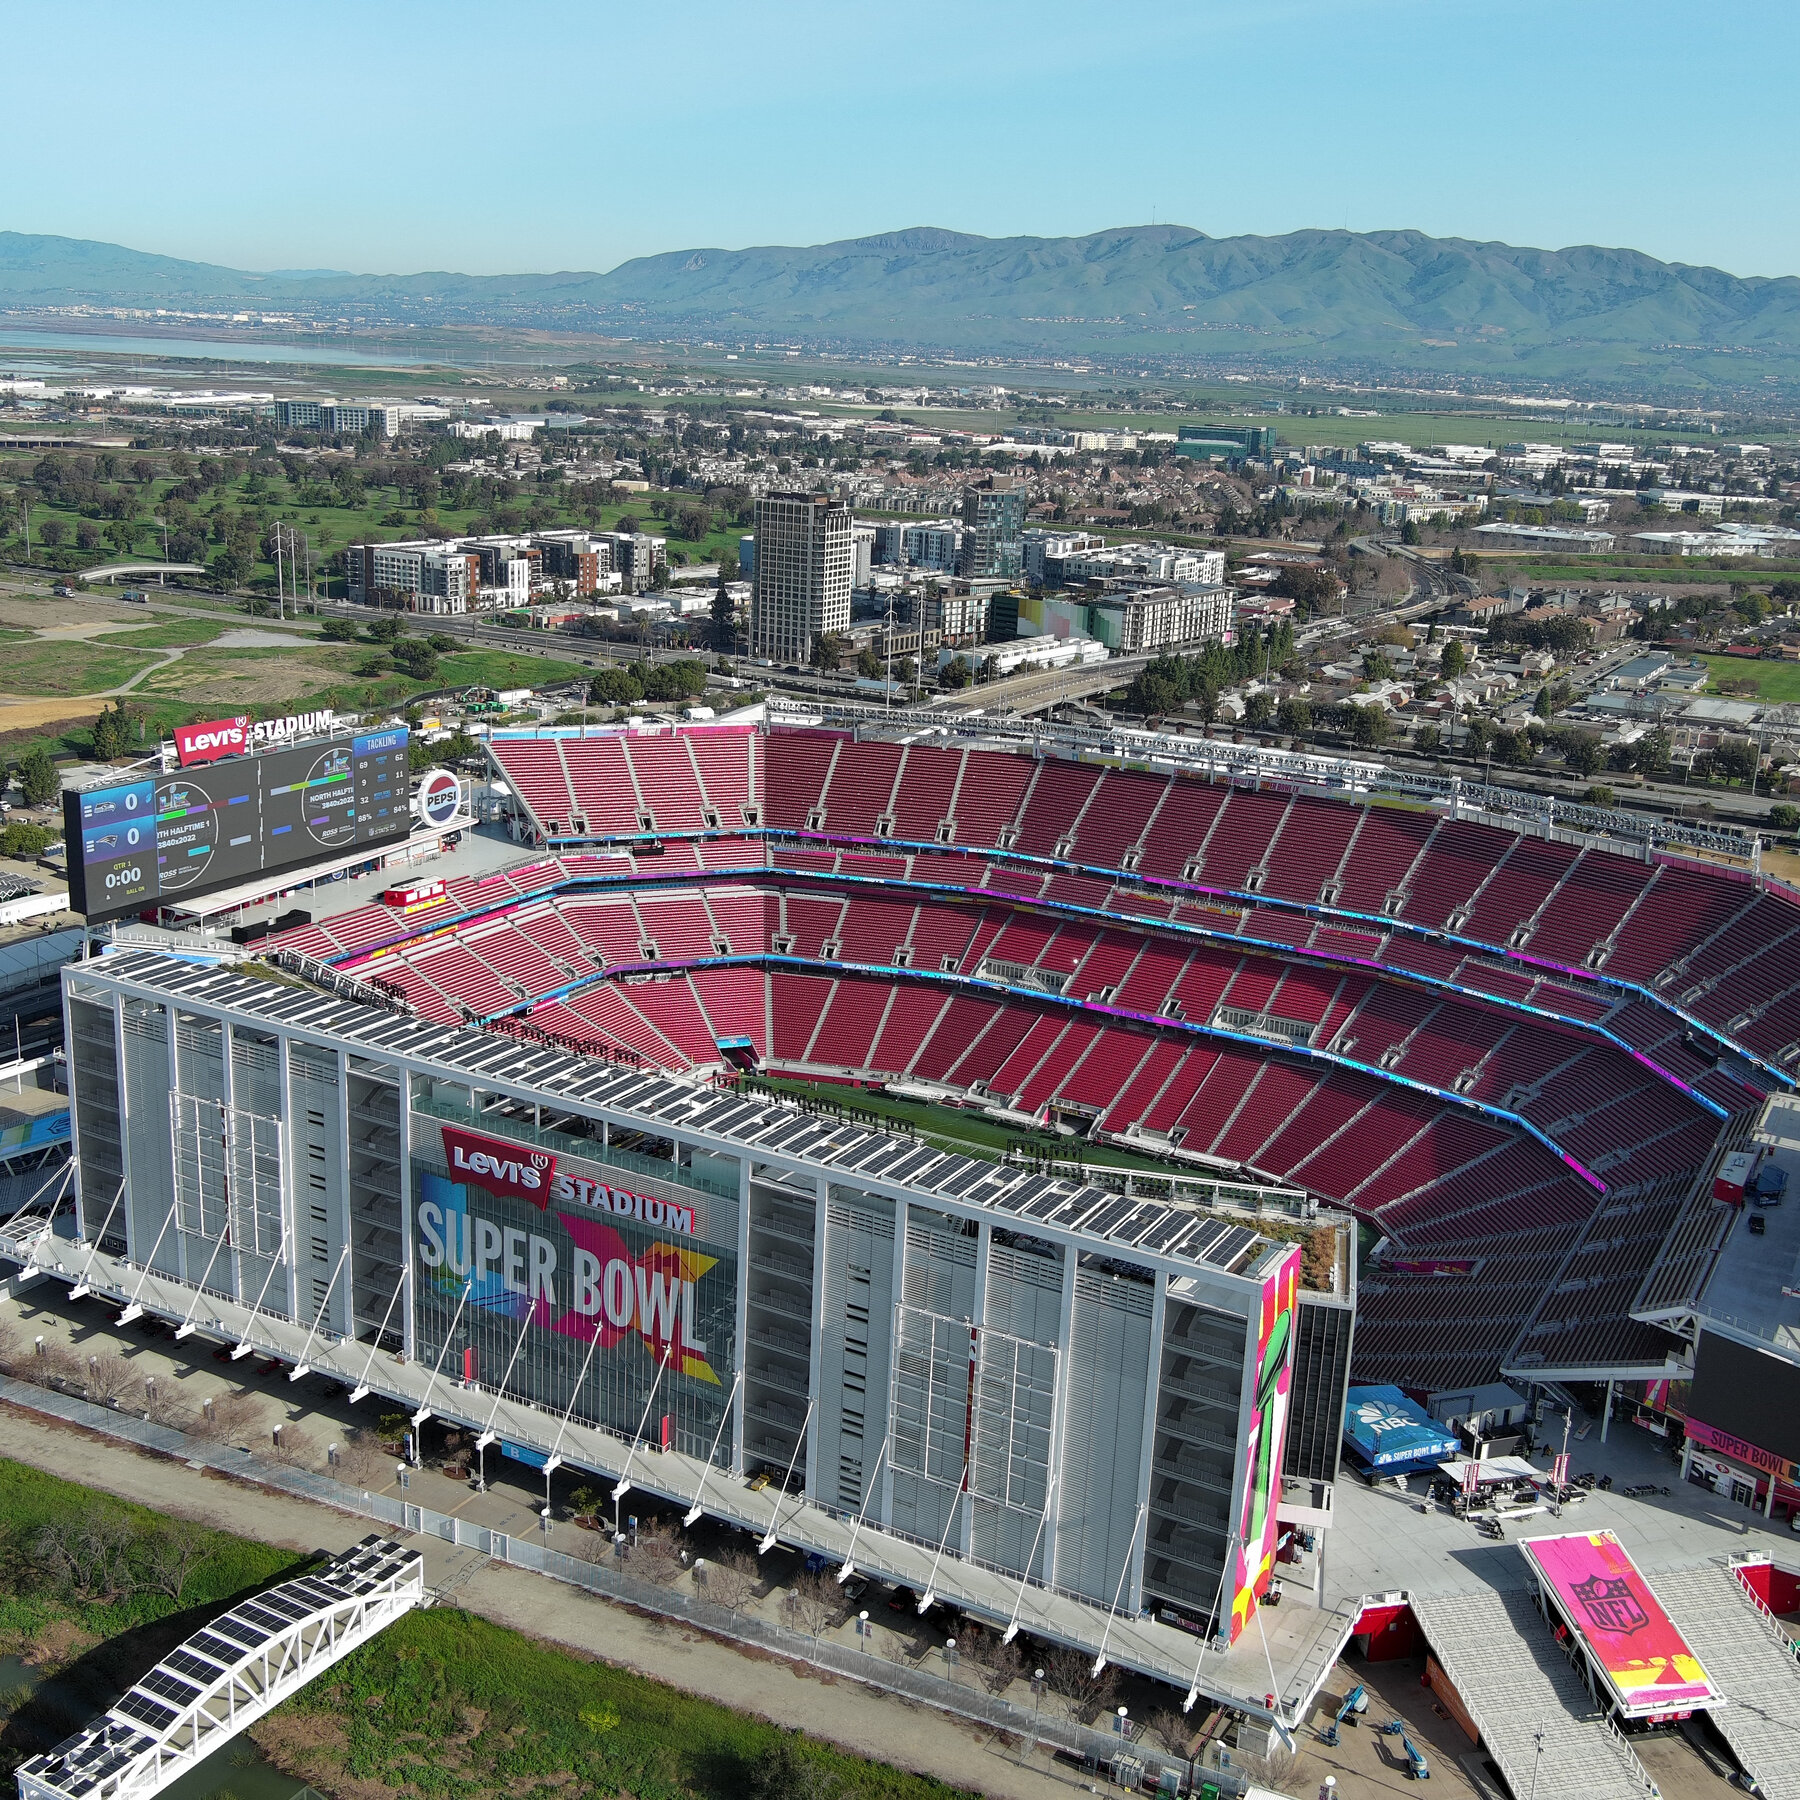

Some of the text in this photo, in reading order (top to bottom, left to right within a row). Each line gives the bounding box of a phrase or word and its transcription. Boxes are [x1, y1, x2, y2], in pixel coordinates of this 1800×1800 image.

[185, 710, 332, 753] Levi's STADIUM
[956, 729, 977, 737] VISA
[367, 735, 397, 750] TACKLING
[359, 761, 368, 769] 69
[395, 788, 404, 796] 37
[1260, 780, 1300, 793] SUPER BOWL LX
[125, 793, 138, 810] 0
[309, 790, 332, 802] NORTH
[360, 796, 369, 804] 32
[427, 790, 457, 806] PEPSI
[127, 828, 139, 845] 0
[170, 821, 204, 836] HALFTIME
[322, 827, 338, 837] ROSS
[105, 867, 141, 888] 0:00
[841, 962, 899, 974] SEAHAWKS
[920, 971, 971, 983] PATRIOTS
[1310, 1049, 1367, 1072] SEAHAWKS
[1389, 1074, 1440, 1096] PATRIOTS
[453, 1147, 695, 1233] Levi's STADIUM
[417, 1201, 707, 1353] SUPER BOWL
[1369, 1416, 1421, 1434] NBC
[510, 1446, 520, 1458] B
[1393, 1450, 1412, 1460] SUPER
[1413, 1446, 1430, 1456] BOWL
[1711, 1430, 1748, 1459] SUPER
[1752, 1447, 1785, 1476] BOWL
[1586, 1599, 1644, 1628] NFL
